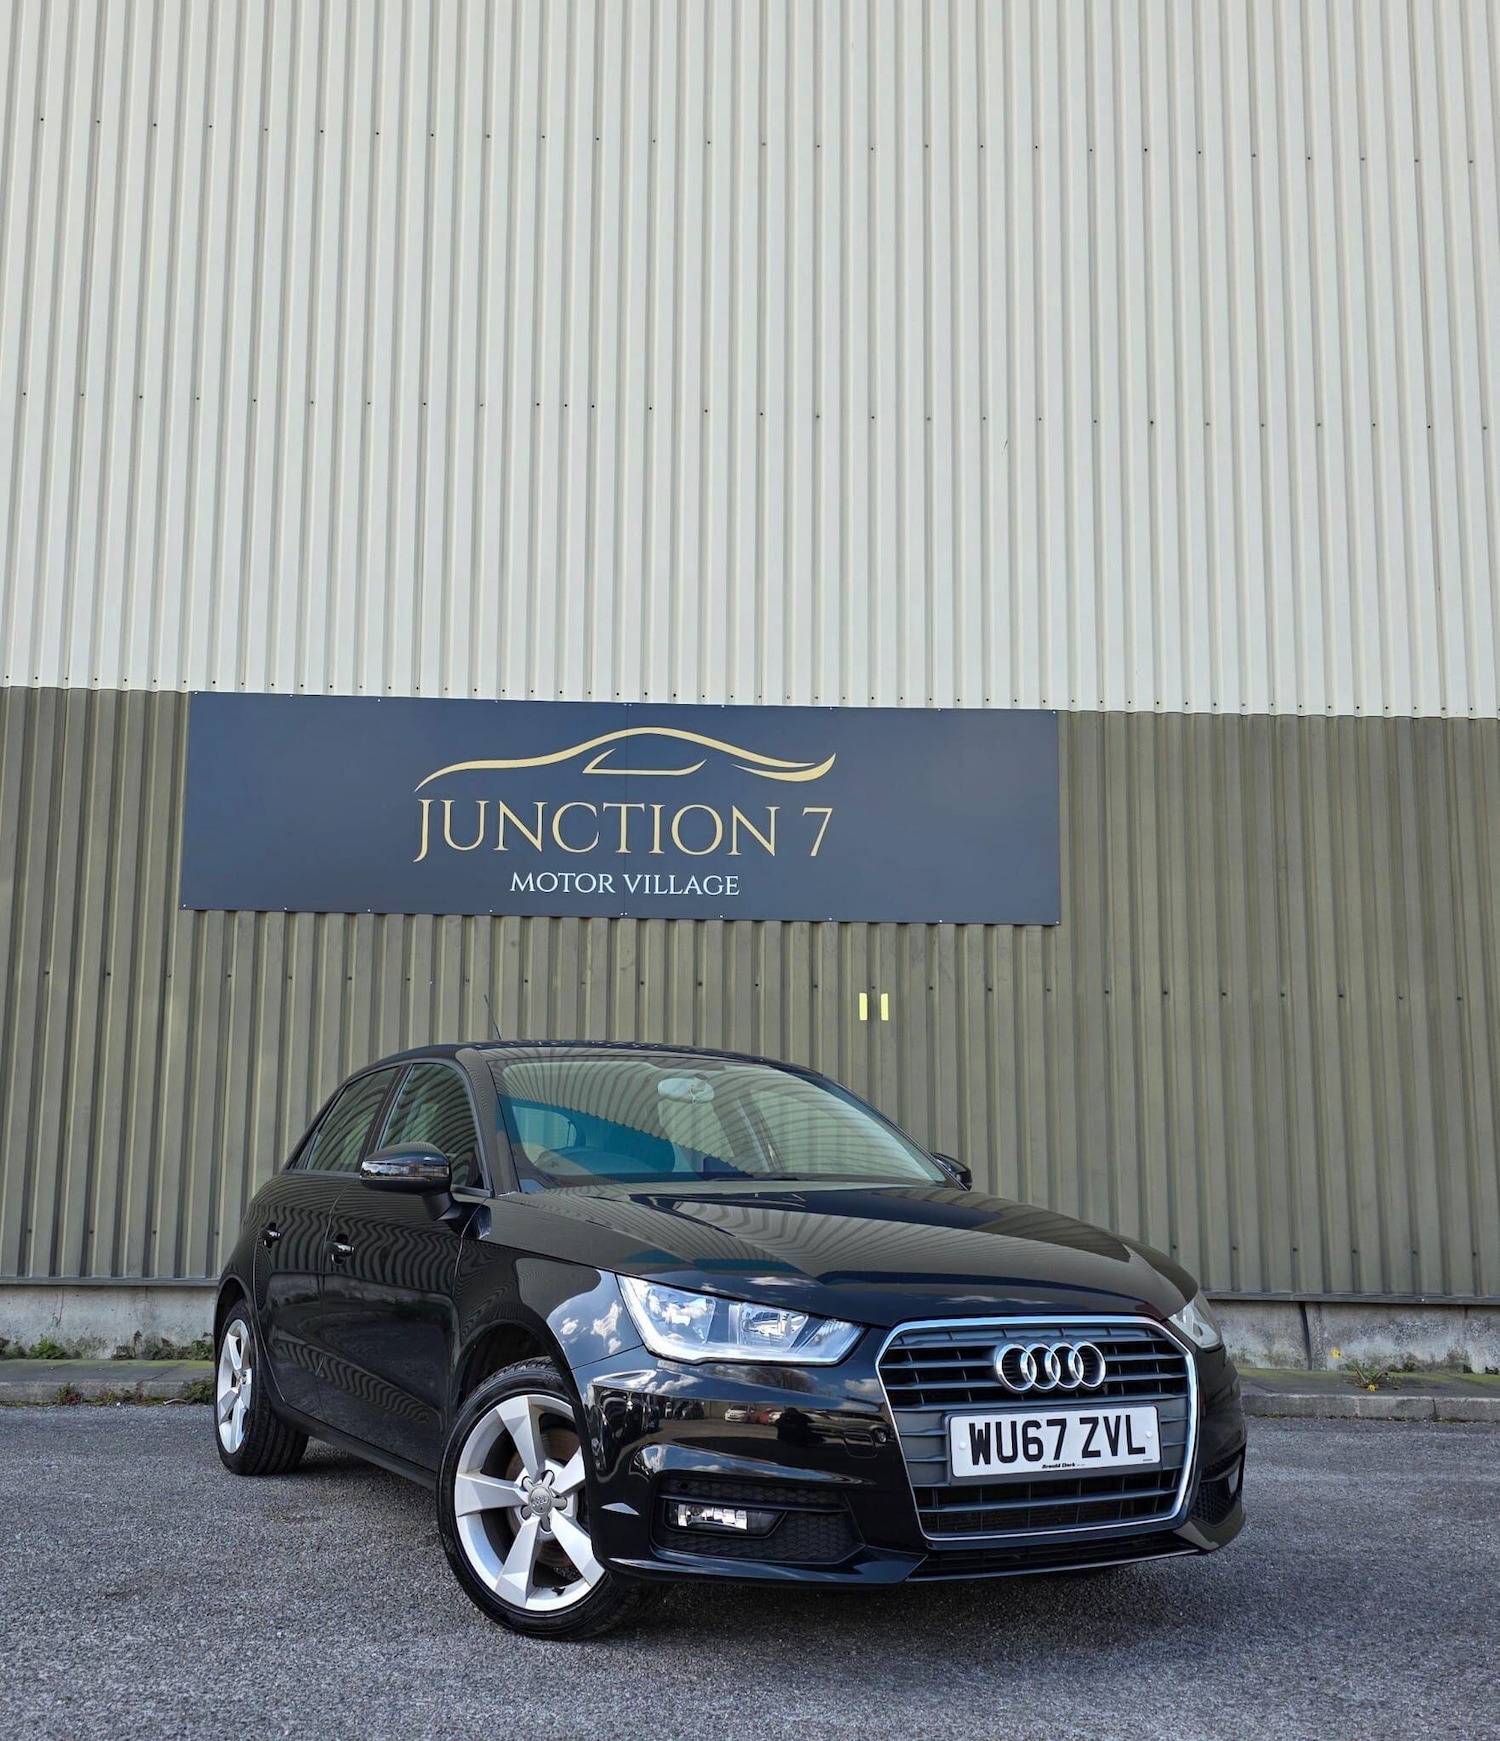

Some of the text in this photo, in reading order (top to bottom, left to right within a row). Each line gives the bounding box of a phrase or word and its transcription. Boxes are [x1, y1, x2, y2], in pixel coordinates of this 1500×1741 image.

[413, 799, 833, 863] JUNCTION 7
[510, 872, 740, 896] MOTOR VILLAGE
[969, 1414, 1146, 1466] WU67 ZVL
